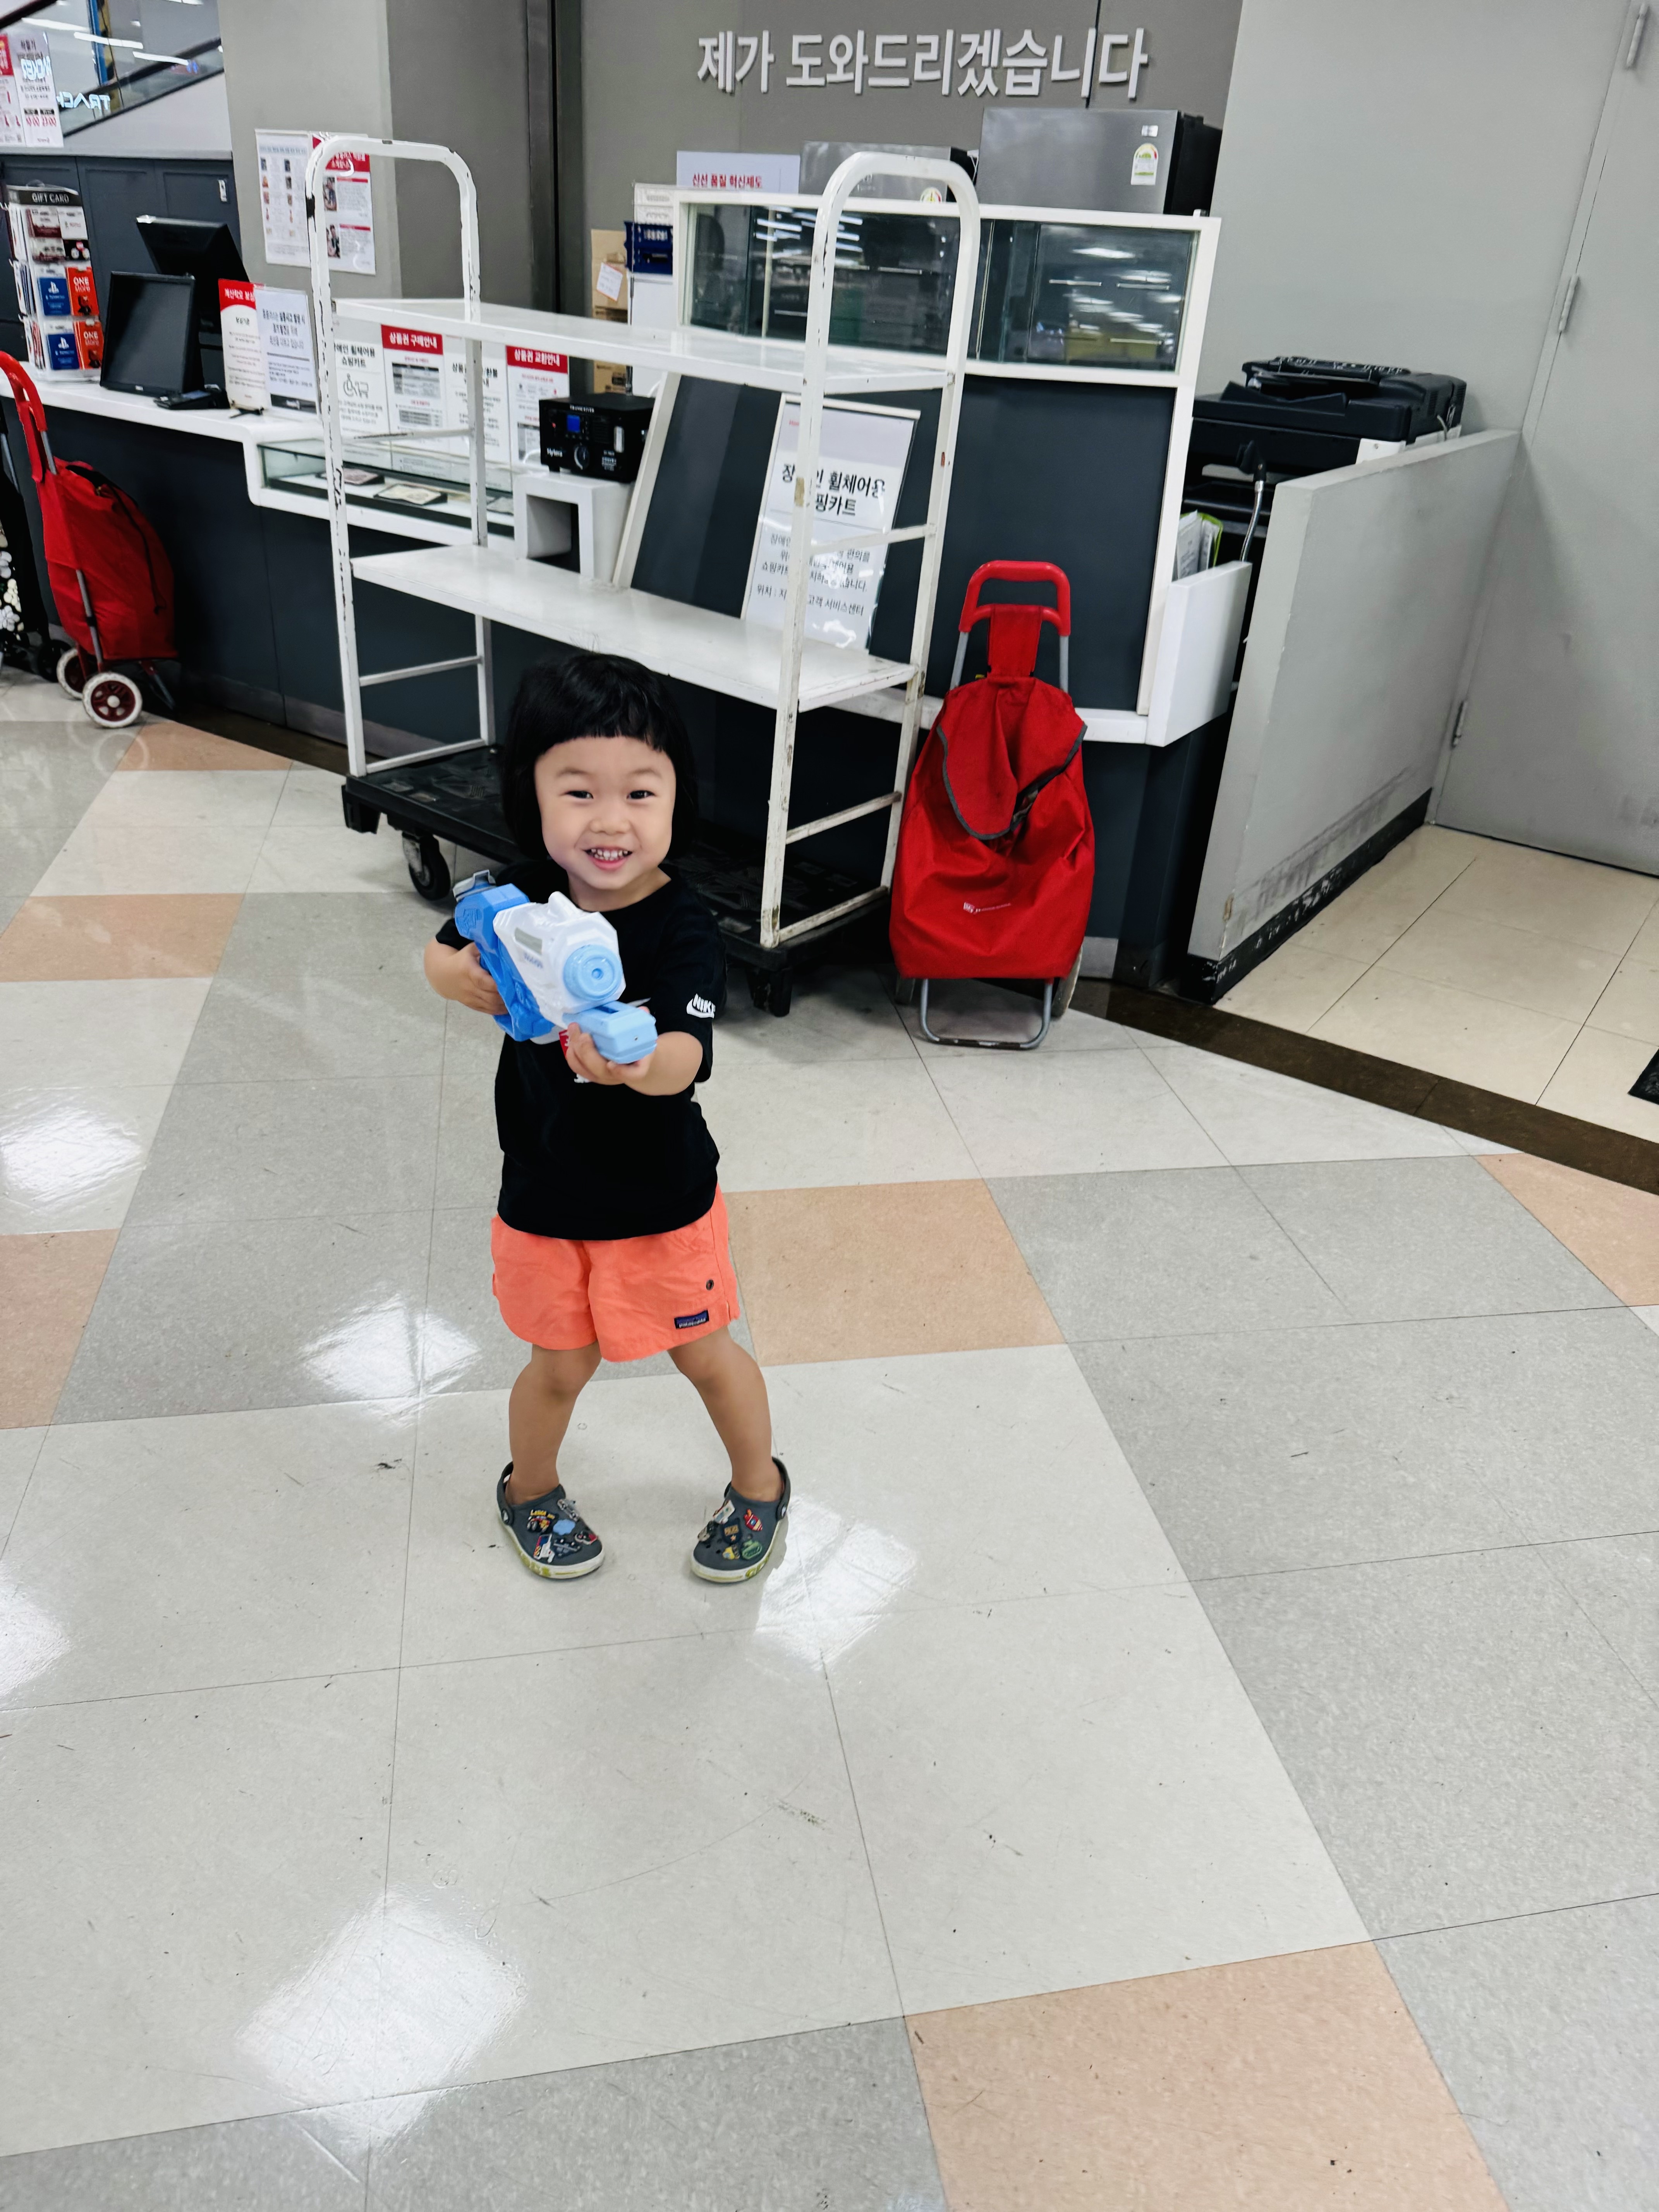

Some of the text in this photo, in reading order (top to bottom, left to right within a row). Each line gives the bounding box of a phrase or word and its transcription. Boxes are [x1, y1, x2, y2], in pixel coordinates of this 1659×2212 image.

[697, 28, 1149, 99] 제가 도와드리겠습니다
[693, 173, 708, 187] 신선
[711, 173, 726, 188] 품질
[32, 193, 69, 204] GIFT CARD
[73, 276, 89, 285] ONE
[83, 331, 98, 339] ONE
[829, 471, 885, 499] 휠체어용
[816, 493, 857, 516] 핑카트
[757, 584, 772, 598] 위치
[824, 598, 864, 616] 서비스센터
